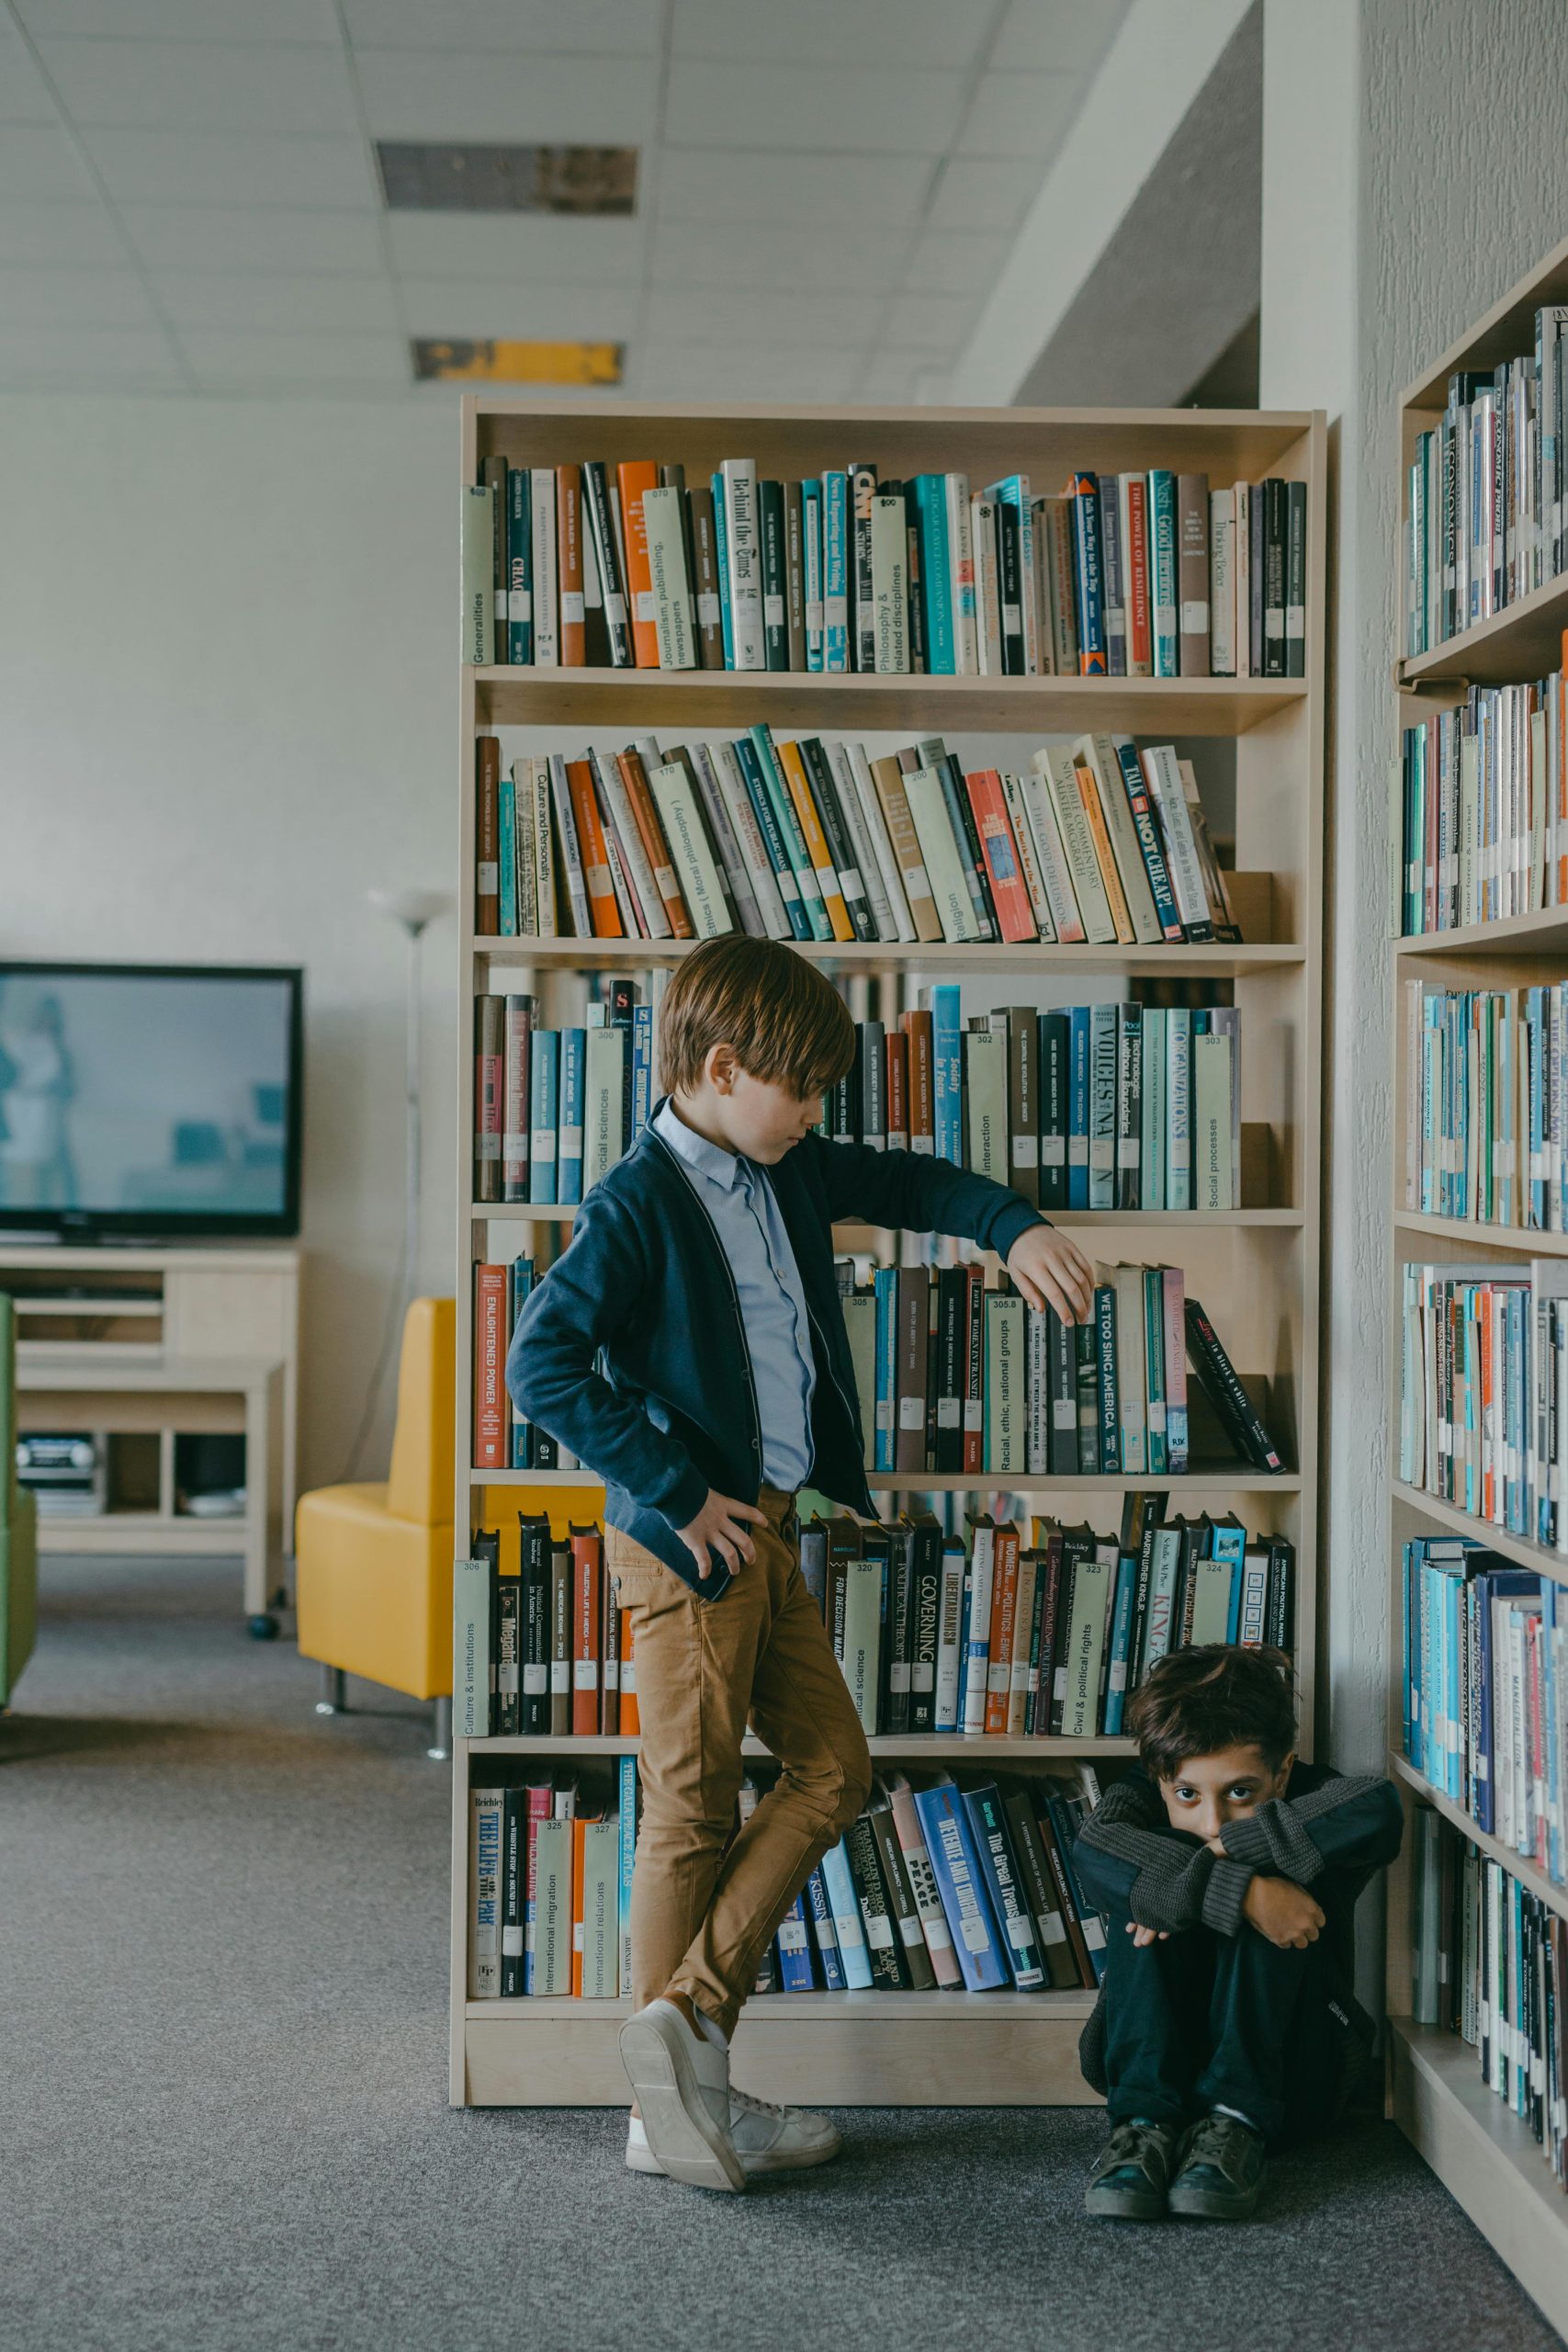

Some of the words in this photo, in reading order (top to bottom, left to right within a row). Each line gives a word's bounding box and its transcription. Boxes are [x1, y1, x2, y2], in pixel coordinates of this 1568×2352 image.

[733, 478, 749, 523] Behind
[830, 477, 840, 499] News
[854, 470, 874, 518] CNN
[1133, 486, 1141, 506] THE
[1158, 479, 1171, 508] Nash
[830, 501, 841, 541] Reporting
[931, 493, 943, 526] EDGAR
[1085, 497, 1094, 514] Talk
[735, 526, 750, 545] the
[1086, 515, 1095, 533] Your
[1134, 511, 1142, 546] POWER
[1157, 514, 1172, 548] Good
[1214, 521, 1227, 558] Thinking
[604, 548, 613, 564] AND
[831, 543, 841, 559] and
[932, 528, 942, 560] CAYCE
[1087, 536, 1096, 551] Way
[1088, 553, 1096, 561] to
[1134, 549, 1143, 564] OF
[512, 558, 524, 591] CHAO
[606, 565, 615, 590] ACTION
[654, 541, 668, 600] publishing,
[736, 548, 755, 579] Times
[831, 560, 842, 592] Writing
[1088, 563, 1097, 575] the
[1158, 550, 1173, 606] Intentions
[1215, 559, 1227, 587] Better
[879, 594, 888, 602] &
[894, 564, 905, 628] disciplines
[933, 560, 945, 621] COMPANION
[1088, 578, 1098, 593] Top
[1135, 567, 1145, 628] RESILIENCE
[473, 593, 484, 663] Generalities
[659, 601, 672, 666] Journalism,
[672, 601, 685, 665] newspapers
[878, 606, 892, 671] Philosophy
[896, 632, 907, 672] related
[660, 766, 675, 776] 170
[911, 771, 928, 781] 200
[1061, 762, 1074, 781] NIV
[1124, 764, 1143, 797] TALK
[537, 775, 548, 808] Culture
[752, 777, 767, 806] ETHICS
[1067, 784, 1081, 811] BIBLE
[1135, 797, 1145, 811] IS
[538, 810, 548, 827] and
[563, 808, 572, 830] VISUAL
[759, 808, 771, 822] FOR
[1014, 815, 1023, 827] The
[1032, 806, 1044, 830] THE
[1056, 779, 1076, 824] ALISTER
[1066, 827, 1085, 876] MCGRATH
[566, 831, 577, 864] ILLUSIONS
[674, 807, 697, 864] philosophy
[762, 823, 779, 851] PUBLIC
[1017, 831, 1029, 853] Battle
[1039, 832, 1052, 861] GOD
[1138, 813, 1157, 854] NOT
[539, 831, 550, 882] Personality
[1023, 857, 1032, 868] for
[1073, 814, 1100, 889] COMMENTARY
[691, 865, 705, 896] Moral
[1025, 870, 1035, 882] the
[1148, 854, 1173, 909] CHEAP!
[1029, 884, 1040, 906] Mind
[1044, 865, 1067, 925] DELUSION
[703, 904, 717, 935] Ethics
[947, 894, 966, 939] Religion
[598, 1031, 614, 1040] 300
[977, 1035, 993, 1044] 302
[1205, 1036, 1221, 1045] 303
[485, 1058, 496, 1080] FIRE
[510, 1035, 524, 1091] Reimagining
[937, 1057, 946, 1069] in
[1097, 1028, 1114, 1100] VOICES
[1122, 1038, 1132, 1078] without
[1132, 1038, 1142, 1099] Technologies
[936, 1070, 947, 1098] Focus
[949, 1057, 961, 1093] Society
[1172, 1032, 1188, 1135] ORGANIZATIONS
[599, 1089, 609, 1139] sciences
[1122, 1080, 1132, 1135] Boundaries
[981, 1115, 992, 1171] interaction
[1209, 1118, 1218, 1172] processes
[1210, 1176, 1219, 1207] Social
[852, 1298, 867, 1306] 305
[993, 1300, 1017, 1308] 305.8
[1101, 1293, 1111, 1312] WE
[486, 1296, 497, 1366] ENLIGHTENED
[971, 1318, 980, 1350] WOMEN
[1000, 1319, 1010, 1356] groups
[1101, 1314, 1111, 1340] TOO
[1102, 1342, 1112, 1372] SING
[486, 1368, 497, 1404] POWER
[1001, 1360, 1011, 1401] national
[1211, 1343, 1220, 1352] in
[1217, 1354, 1232, 1375] black
[1233, 1387, 1247, 1408] white
[1103, 1374, 1114, 1429] AMERICA
[1000, 1405, 1010, 1433] ethic,
[1000, 1436, 1010, 1471] Racial,
[1005, 1541, 1017, 1575] WOMEN
[1143, 1531, 1152, 1558] MARTIN
[464, 1562, 479, 1570] 306
[1086, 1565, 1102, 1573] 323
[1141, 1559, 1150, 1582] LUTHER
[1206, 1564, 1222, 1572] 324
[536, 1585, 544, 1613] Political
[835, 1577, 844, 1593] FOR
[896, 1563, 906, 1616] POLITICAL
[528, 1595, 536, 1623] America
[834, 1595, 843, 1634] DECISION
[919, 1575, 937, 1662] GOVERNING
[942, 1572, 959, 1645] LIBERTARIANISM
[1002, 1592, 1013, 1632] POLITICS
[1044, 1602, 1055, 1637] WOMEN
[1150, 1594, 1170, 1646] KING
[467, 1623, 476, 1683] institutions
[501, 1617, 515, 1663] Megatre
[896, 1619, 906, 1655] THEORY
[1080, 1623, 1092, 1655] rights
[856, 1649, 865, 1689] science
[1042, 1645, 1051, 1687] POLITICS
[1077, 1657, 1089, 1698] political
[465, 1686, 474, 1694] &
[465, 1696, 474, 1735] Culture
[1074, 1712, 1084, 1735] Civil
[624, 1787, 634, 1813] GAIA
[479, 1812, 499, 1842] THE
[547, 1822, 562, 1830] 325
[595, 1826, 610, 1834] 327
[624, 1815, 634, 1849] PEACE
[987, 1832, 1004, 1853] The
[479, 1844, 499, 1876] LIFE
[860, 1822, 880, 1880] FRANKLIN
[938, 1818, 961, 1860] DETENTE
[950, 1860, 970, 1883] AND
[623, 1851, 633, 1887] ATLAS
[909, 1860, 929, 1908] PEACE
[922, 1860, 940, 1905] LONG
[993, 1854, 1012, 1885] Great
[546, 1874, 557, 1924] migration
[596, 1882, 605, 1928] relations
[546, 1926, 556, 1993] International
[594, 1930, 604, 1996] International
